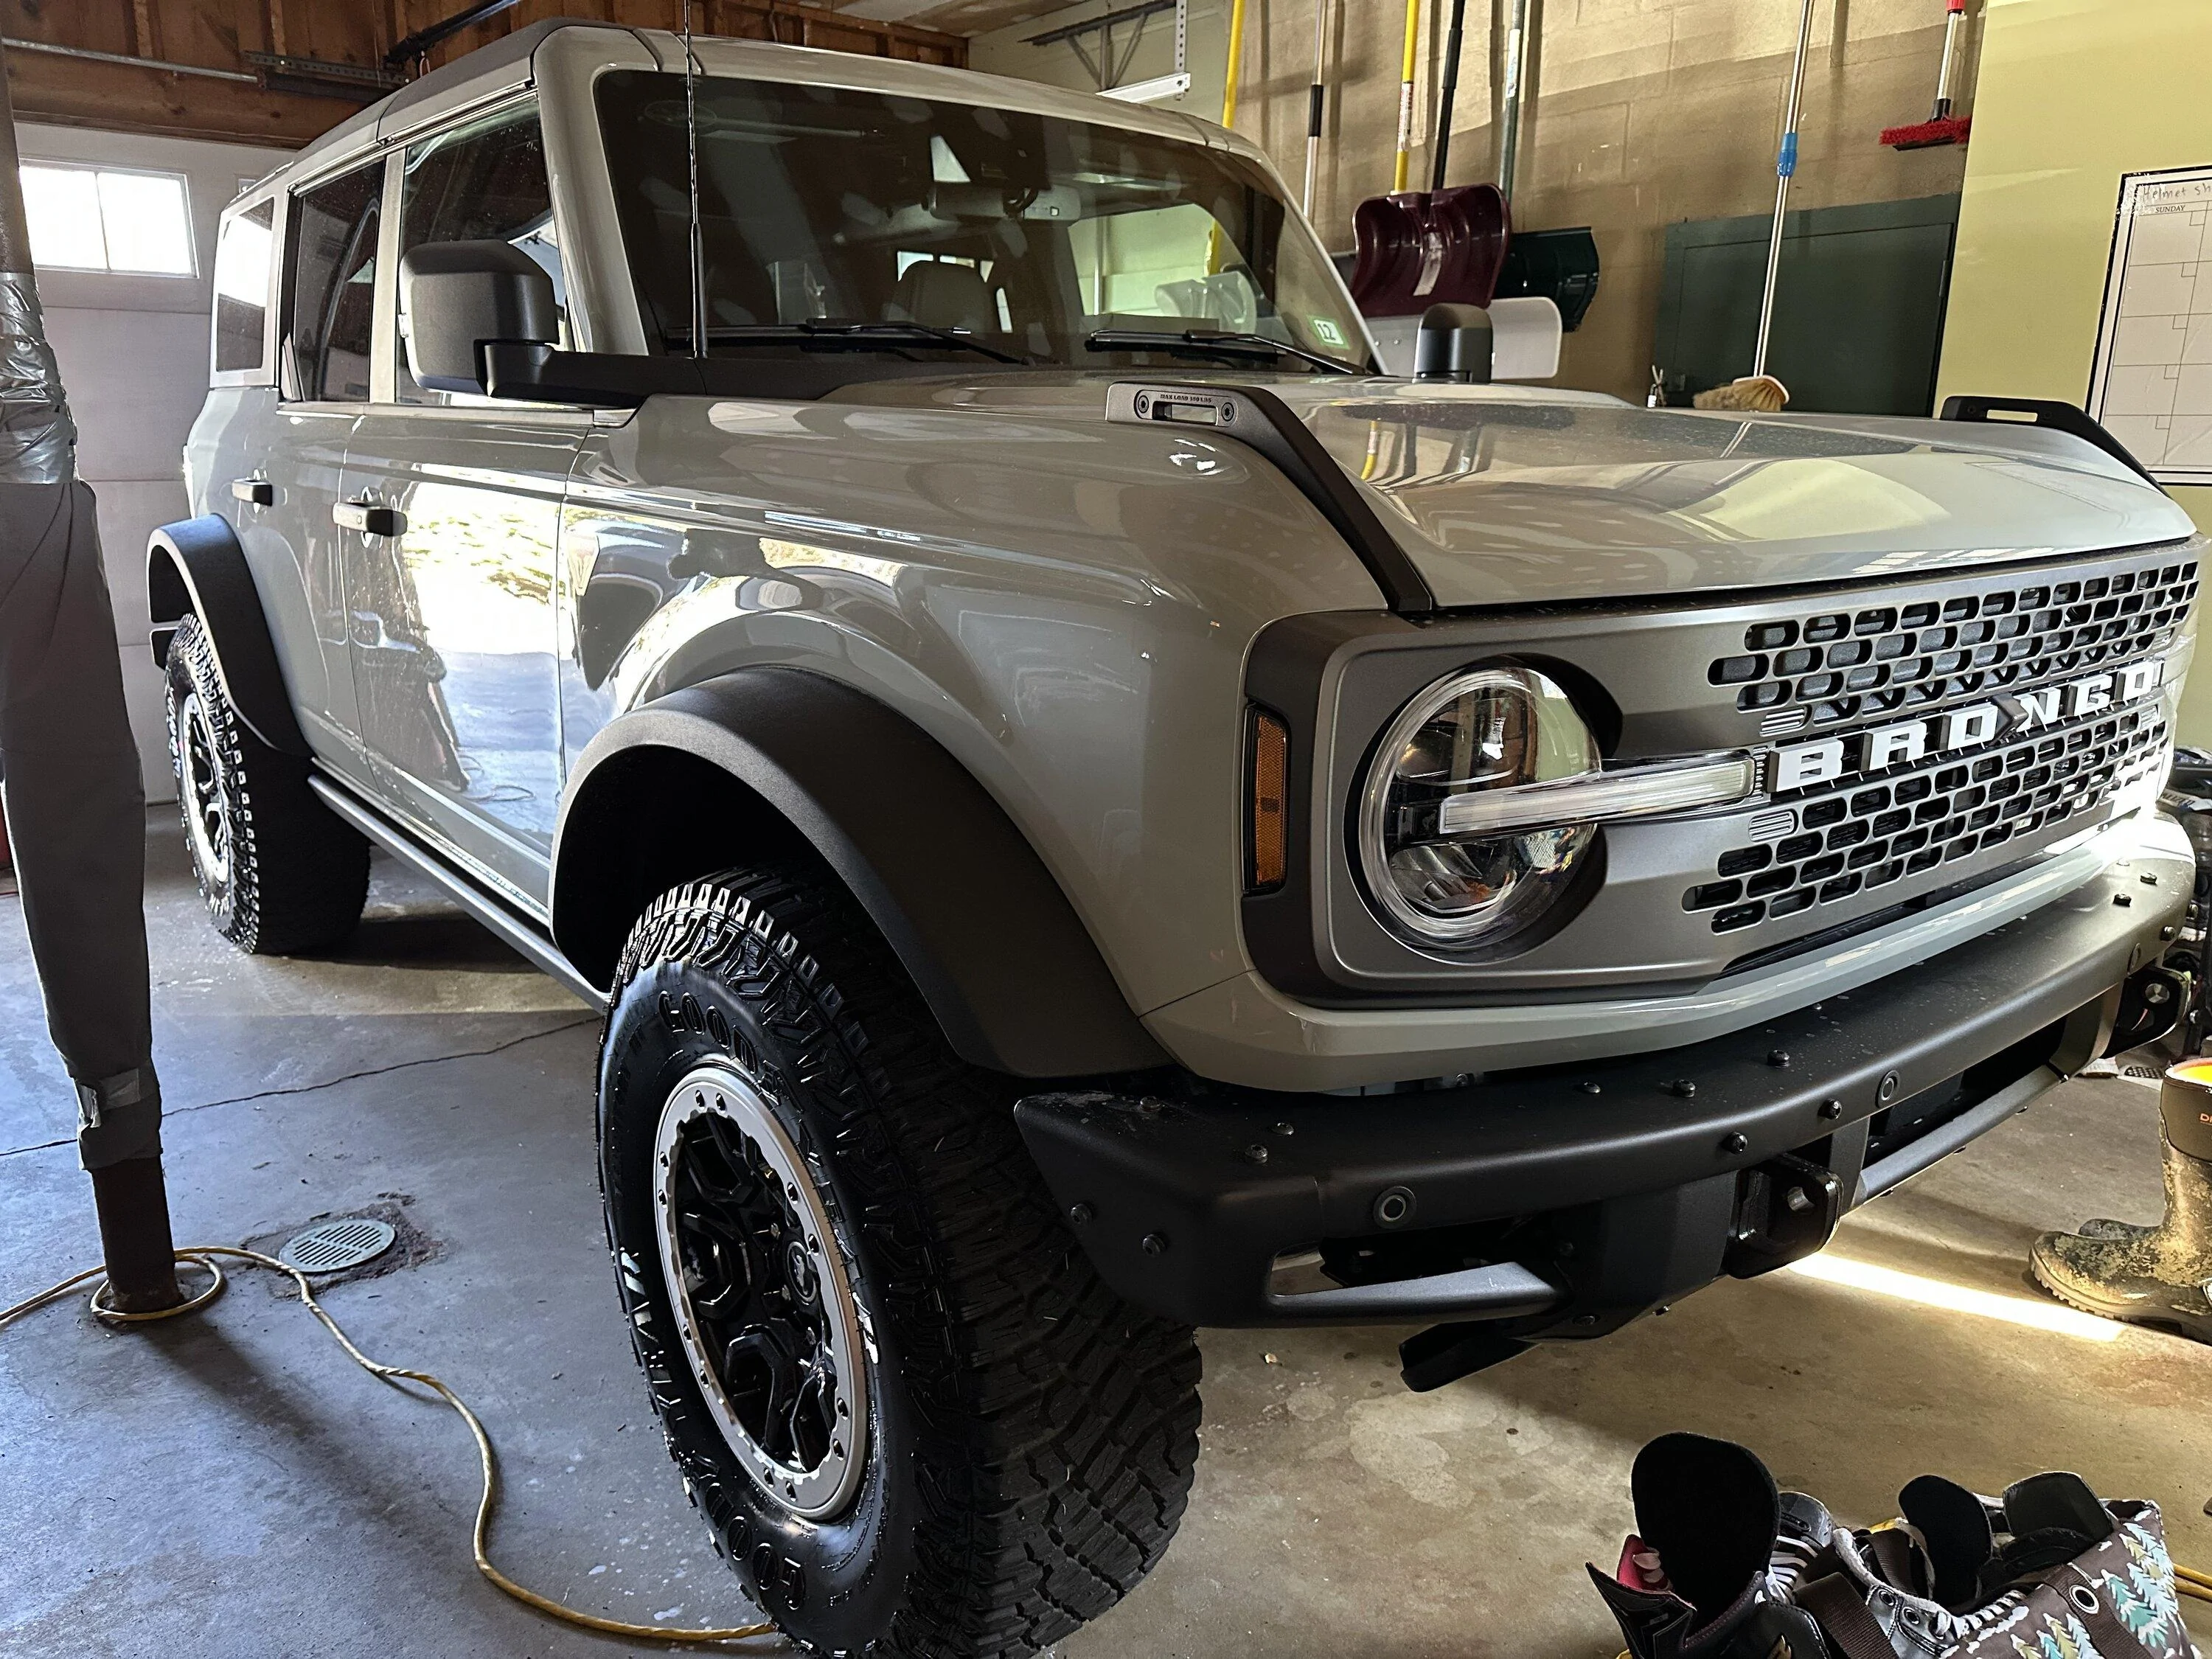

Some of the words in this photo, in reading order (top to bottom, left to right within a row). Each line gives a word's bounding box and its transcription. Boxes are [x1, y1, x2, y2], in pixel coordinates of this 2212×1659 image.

[2143, 184, 2187, 201] Helmet
[2154, 205, 2186, 213] SUNDAY
[1770, 662, 2160, 792] BRONCO
